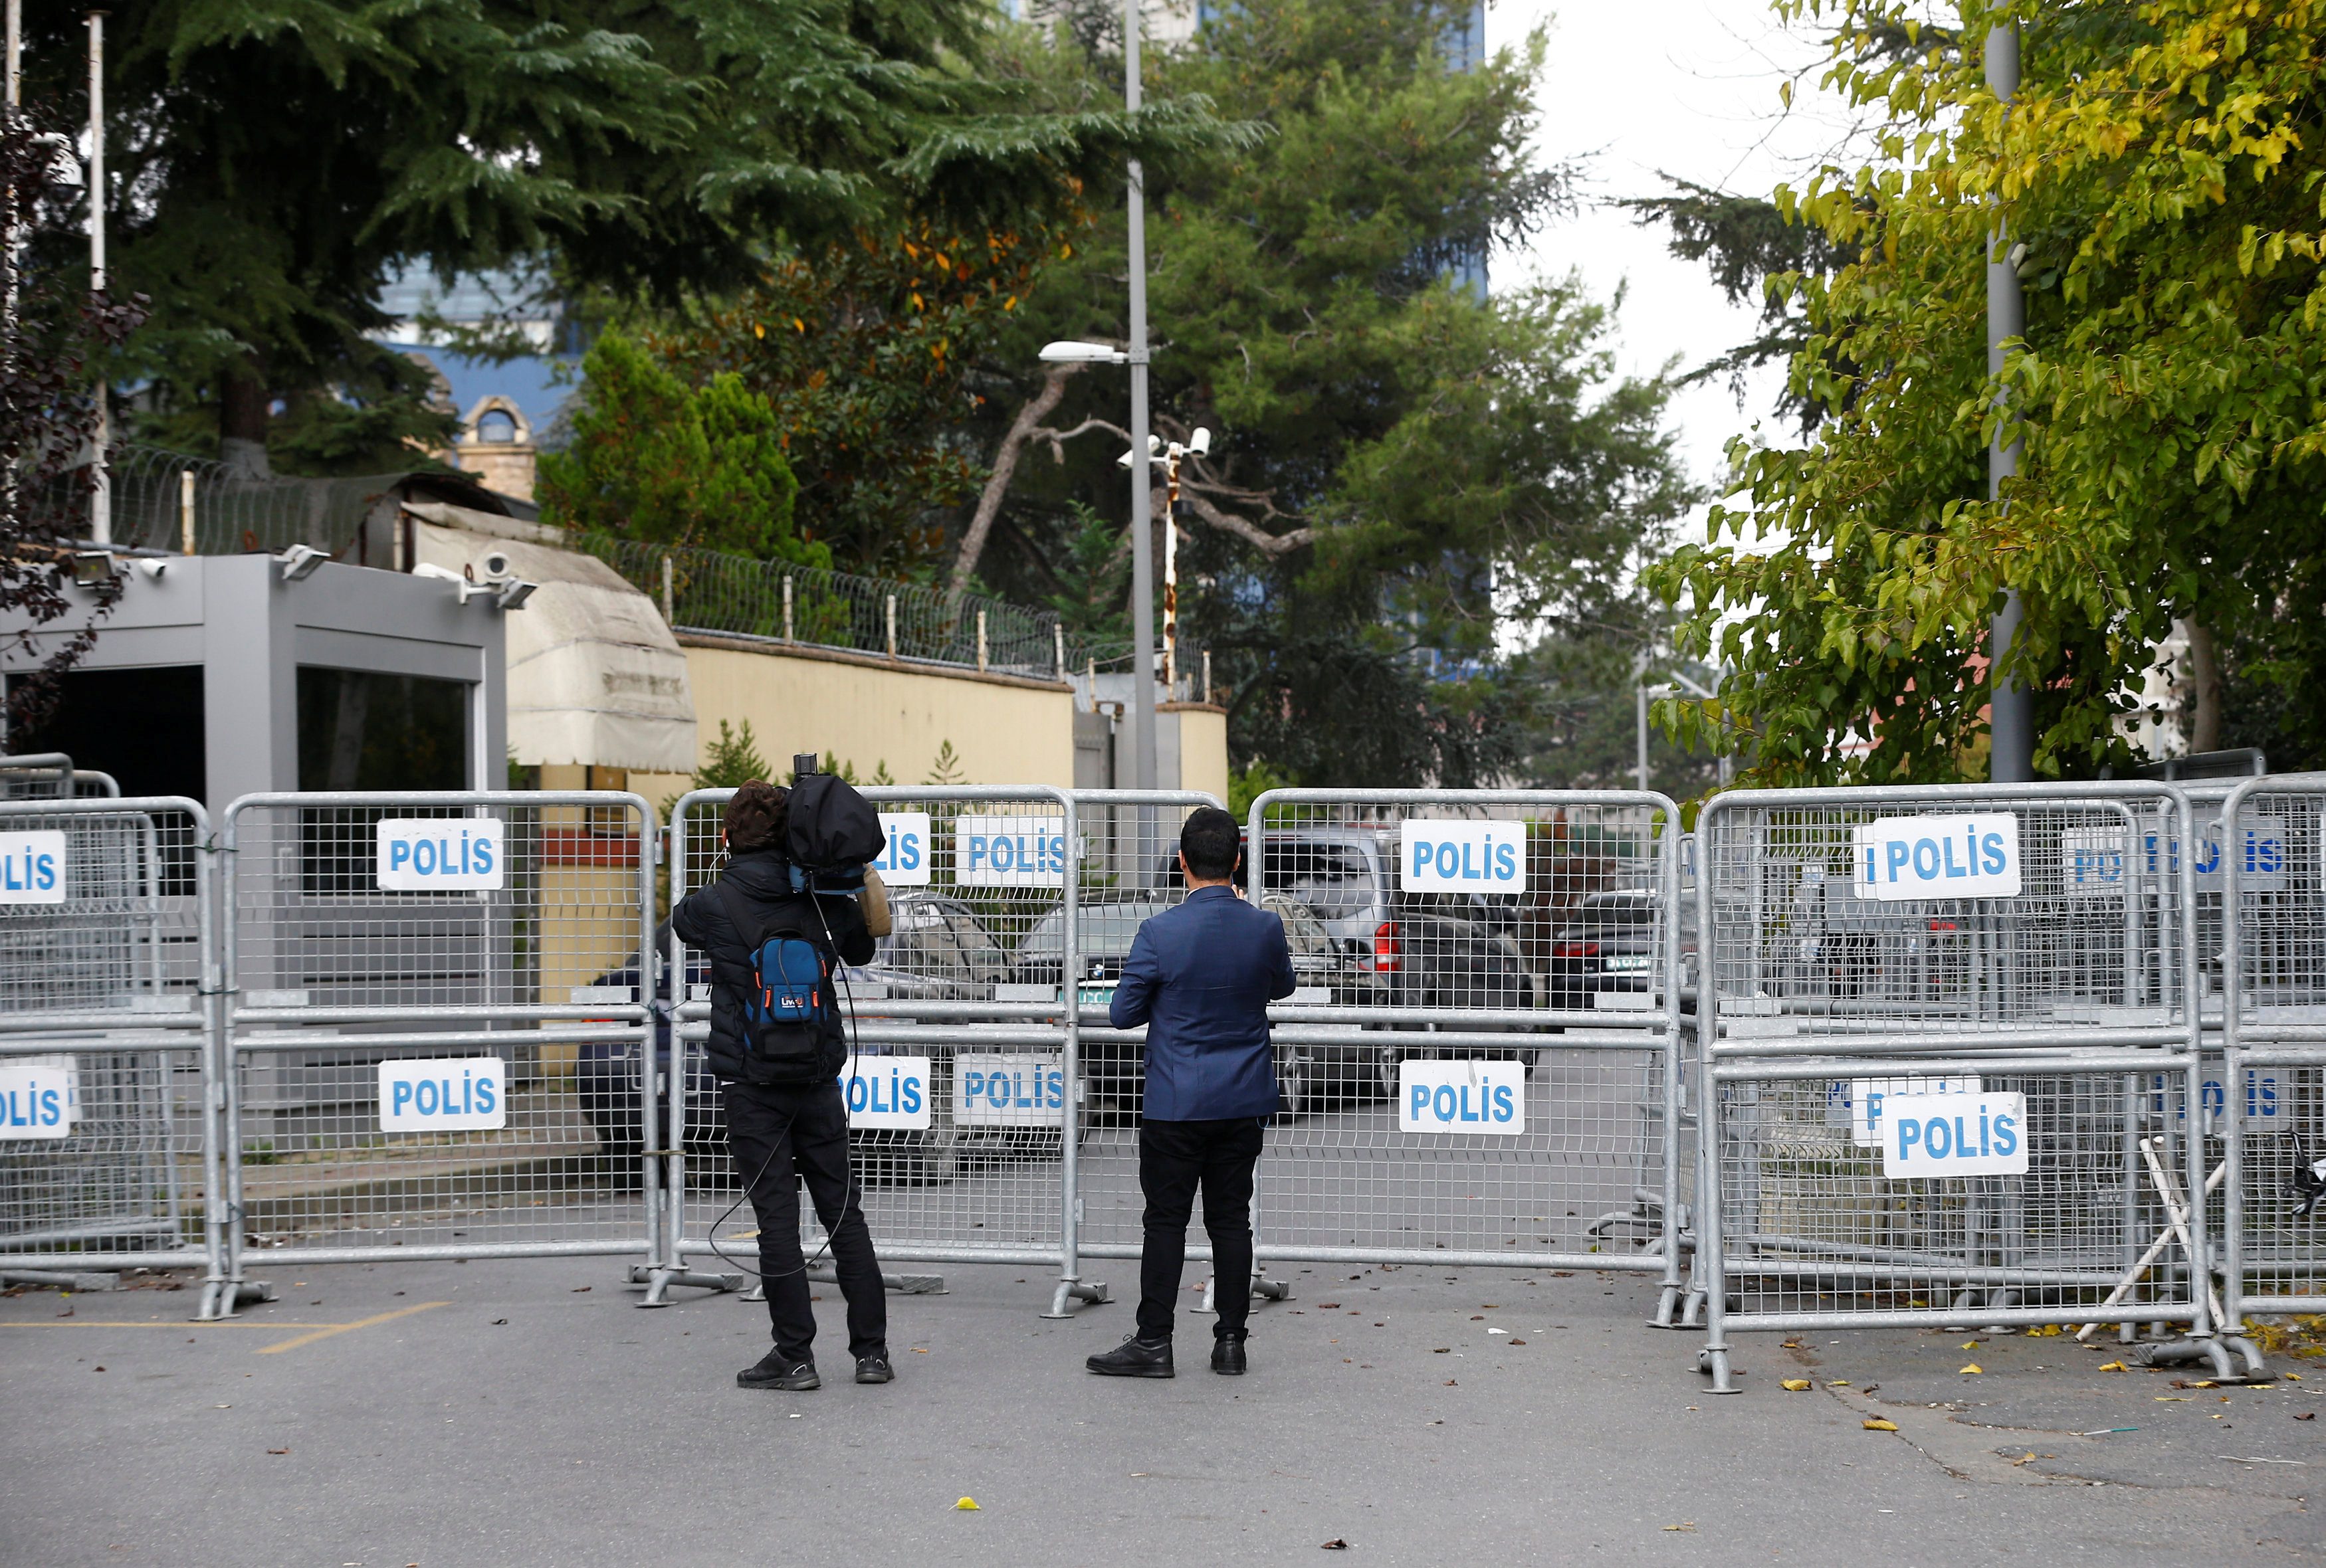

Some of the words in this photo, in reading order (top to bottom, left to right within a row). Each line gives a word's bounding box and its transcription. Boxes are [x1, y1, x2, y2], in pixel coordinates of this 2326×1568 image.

[0, 845, 55, 890] LİS
[391, 830, 493, 875] POLİS
[969, 828, 1064, 872] POLİS
[1414, 834, 1516, 880] POLİS
[1887, 825, 2006, 882] POLİS
[0, 1081, 60, 1126] LİS
[393, 1070, 495, 1117] POLİS
[966, 1064, 1063, 1108] POLİS
[1412, 1076, 1514, 1123] POLİS
[1898, 1105, 2017, 1160] POLİS
